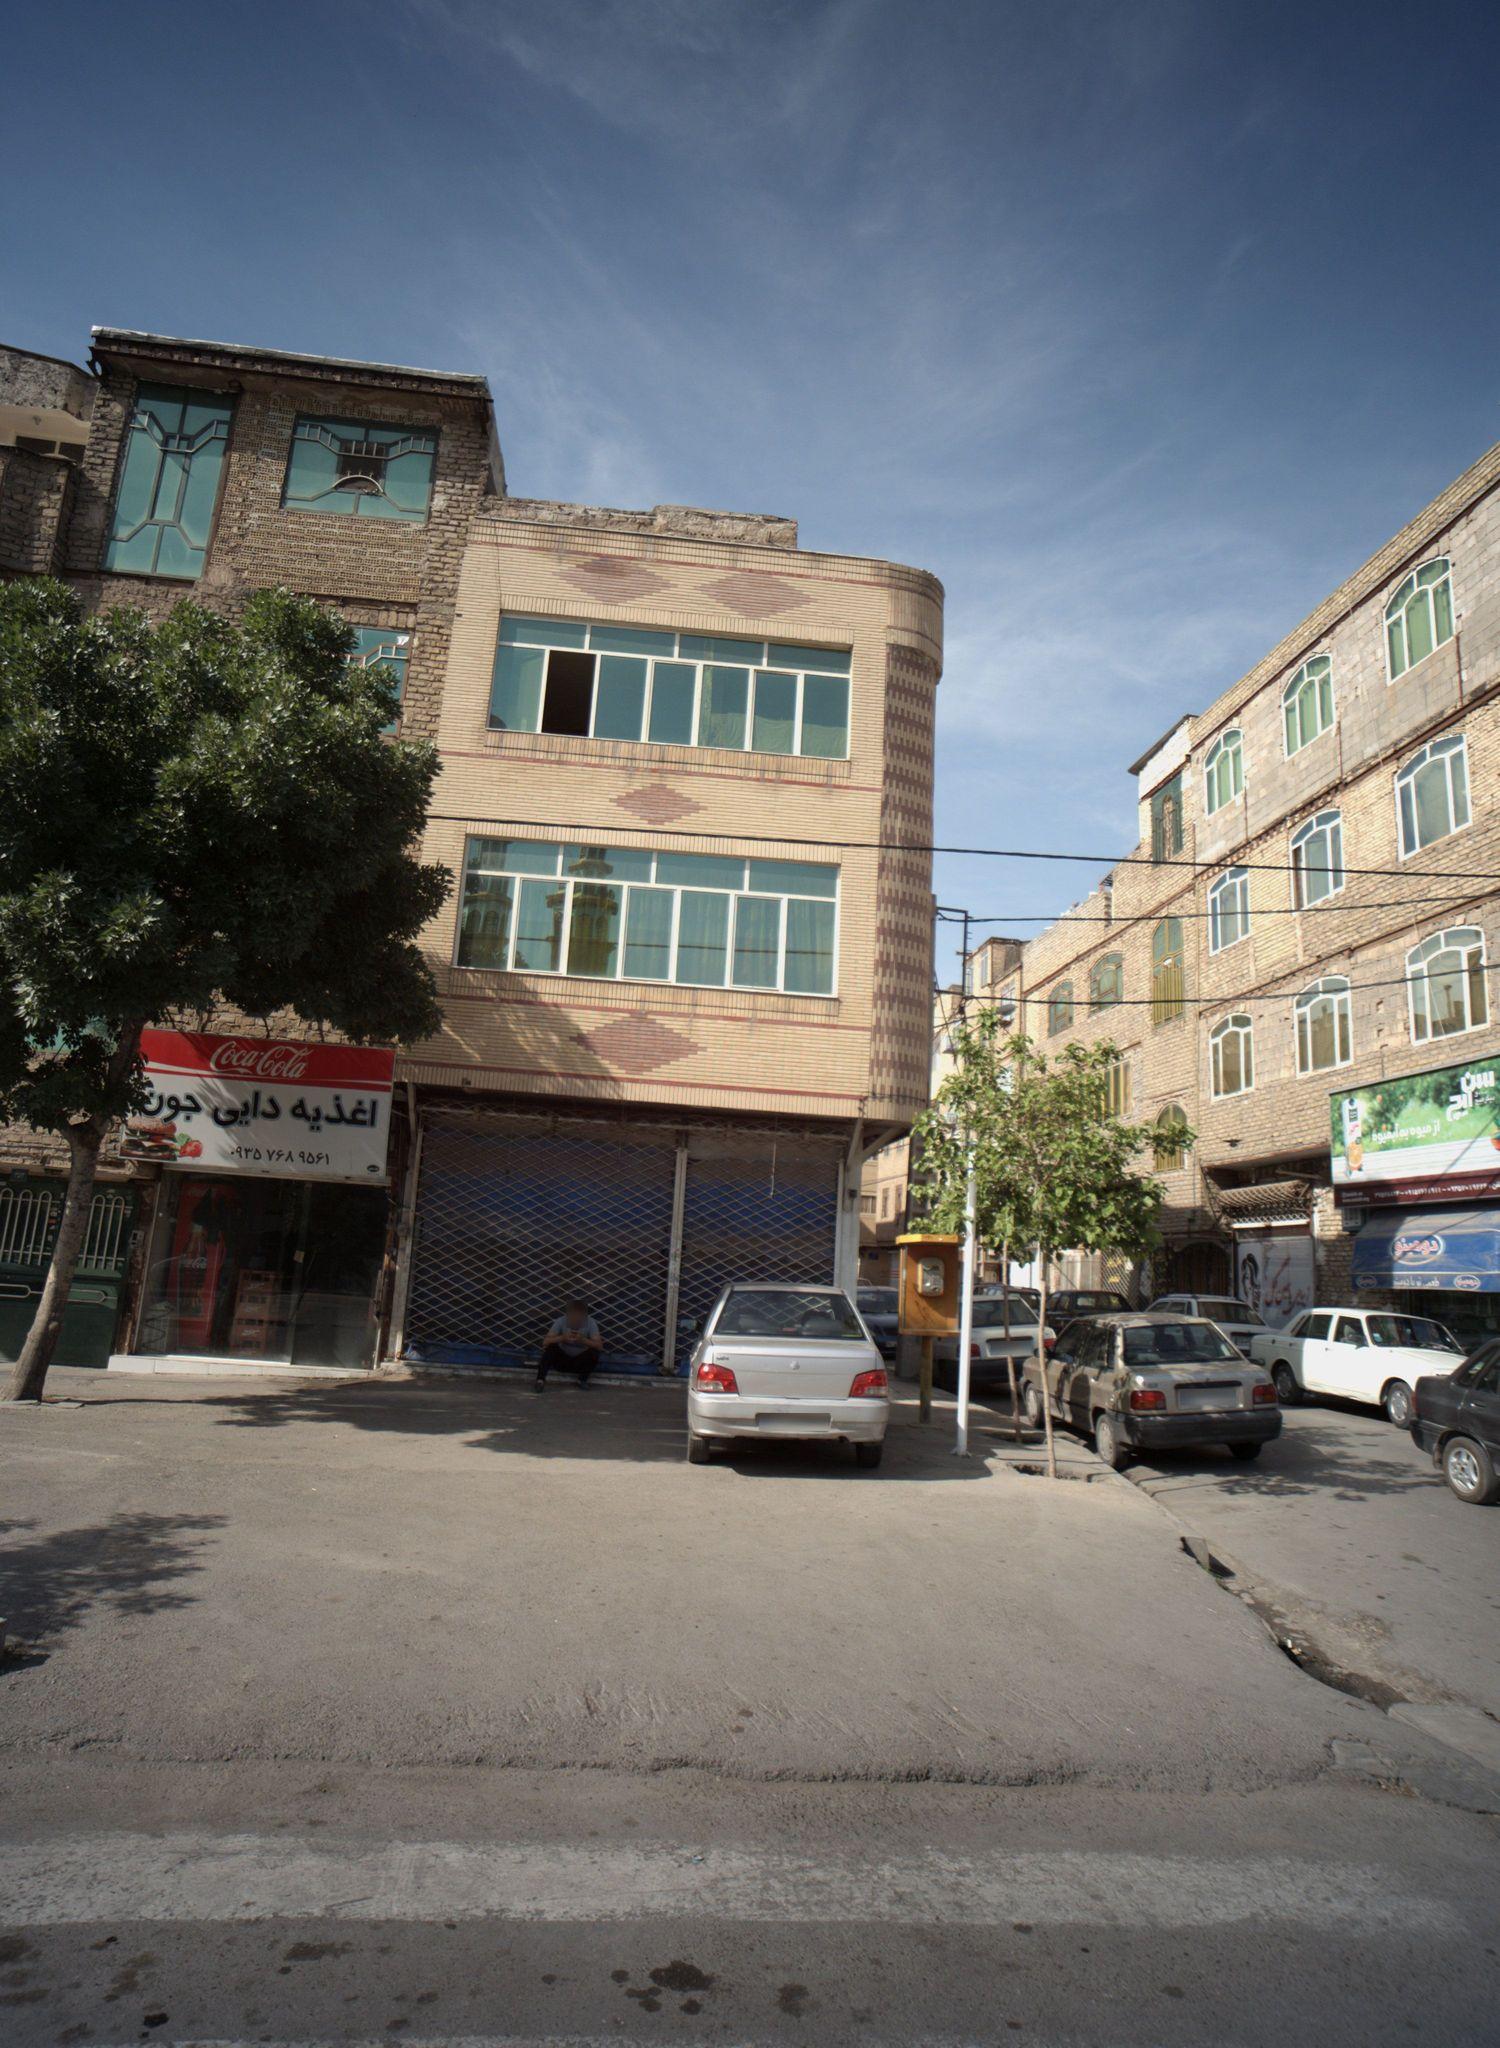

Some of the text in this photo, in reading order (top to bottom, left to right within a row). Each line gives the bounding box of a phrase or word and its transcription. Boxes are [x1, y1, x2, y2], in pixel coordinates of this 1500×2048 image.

[210, 1041, 314, 1078] Coca-Cola
[142, 1090, 378, 1132] اغذیه دایی جون
[230, 1145, 330, 1165] ۰۹۳۵ ۷۶۸ ۹۵۶۱
